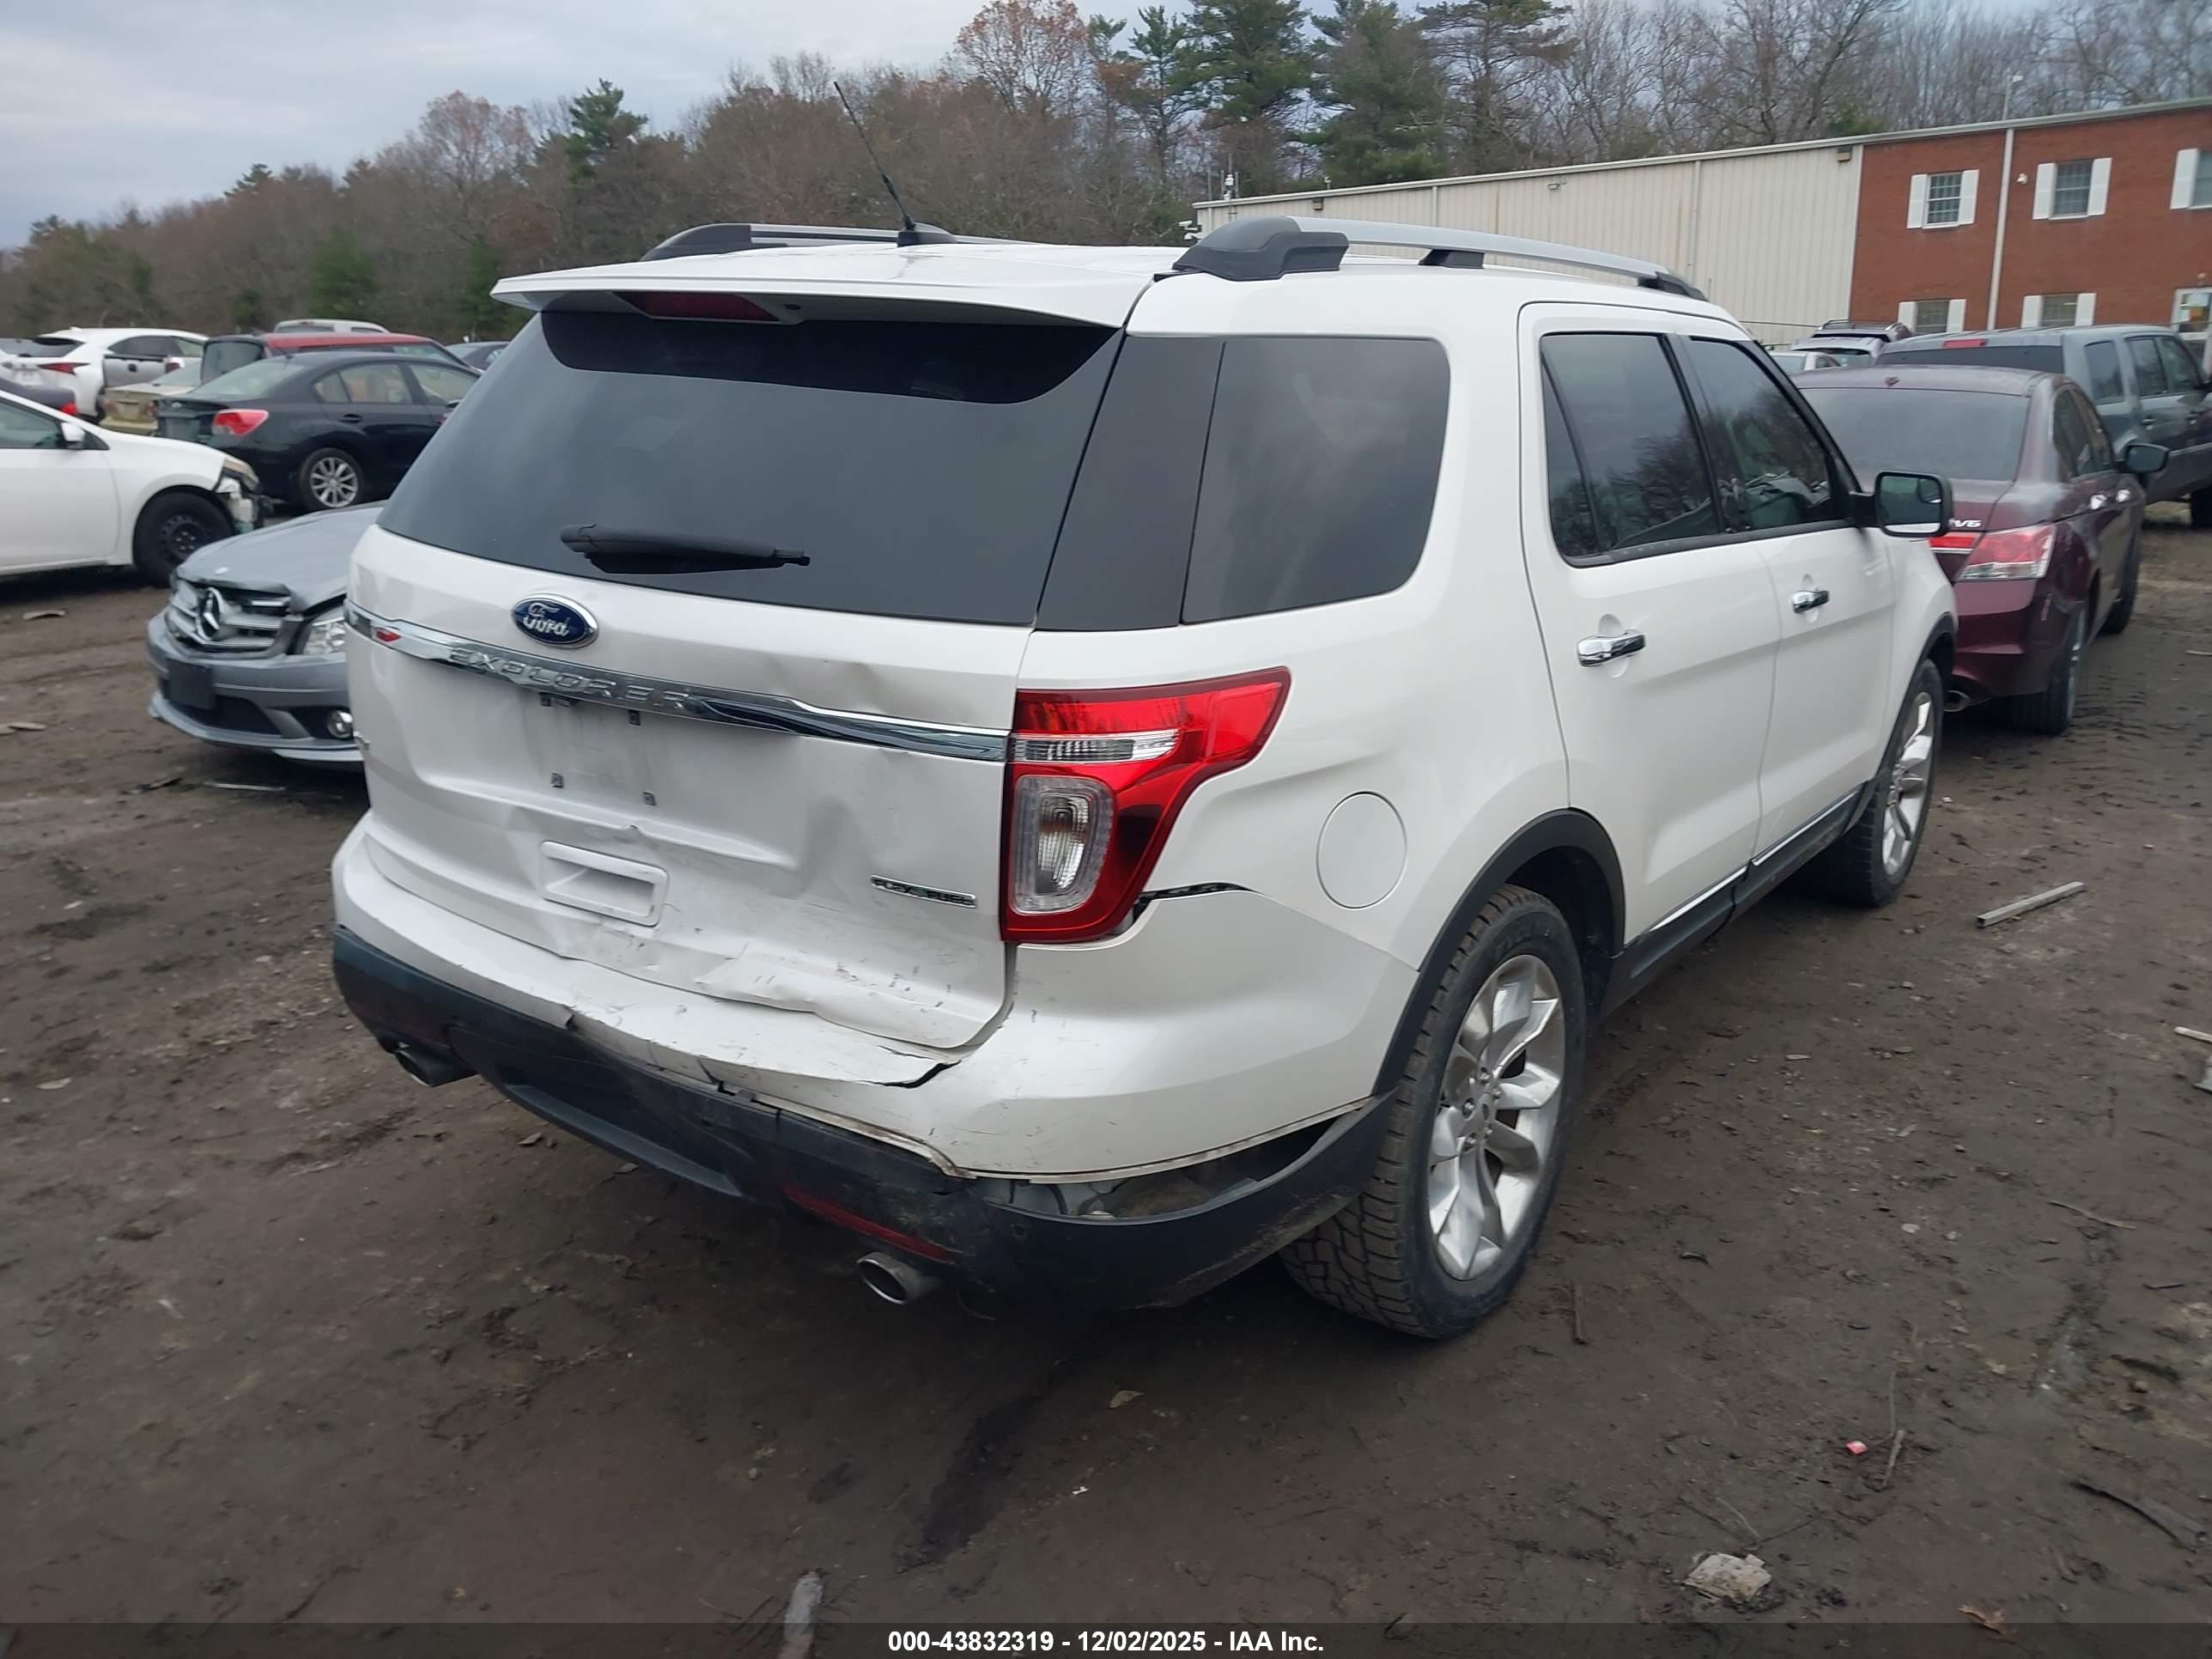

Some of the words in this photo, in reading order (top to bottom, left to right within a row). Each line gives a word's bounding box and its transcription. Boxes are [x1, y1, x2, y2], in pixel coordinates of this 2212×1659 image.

[1950, 519, 1982, 528] V6
[522, 602, 569, 636] Ford
[449, 647, 689, 709] EXPLORER
